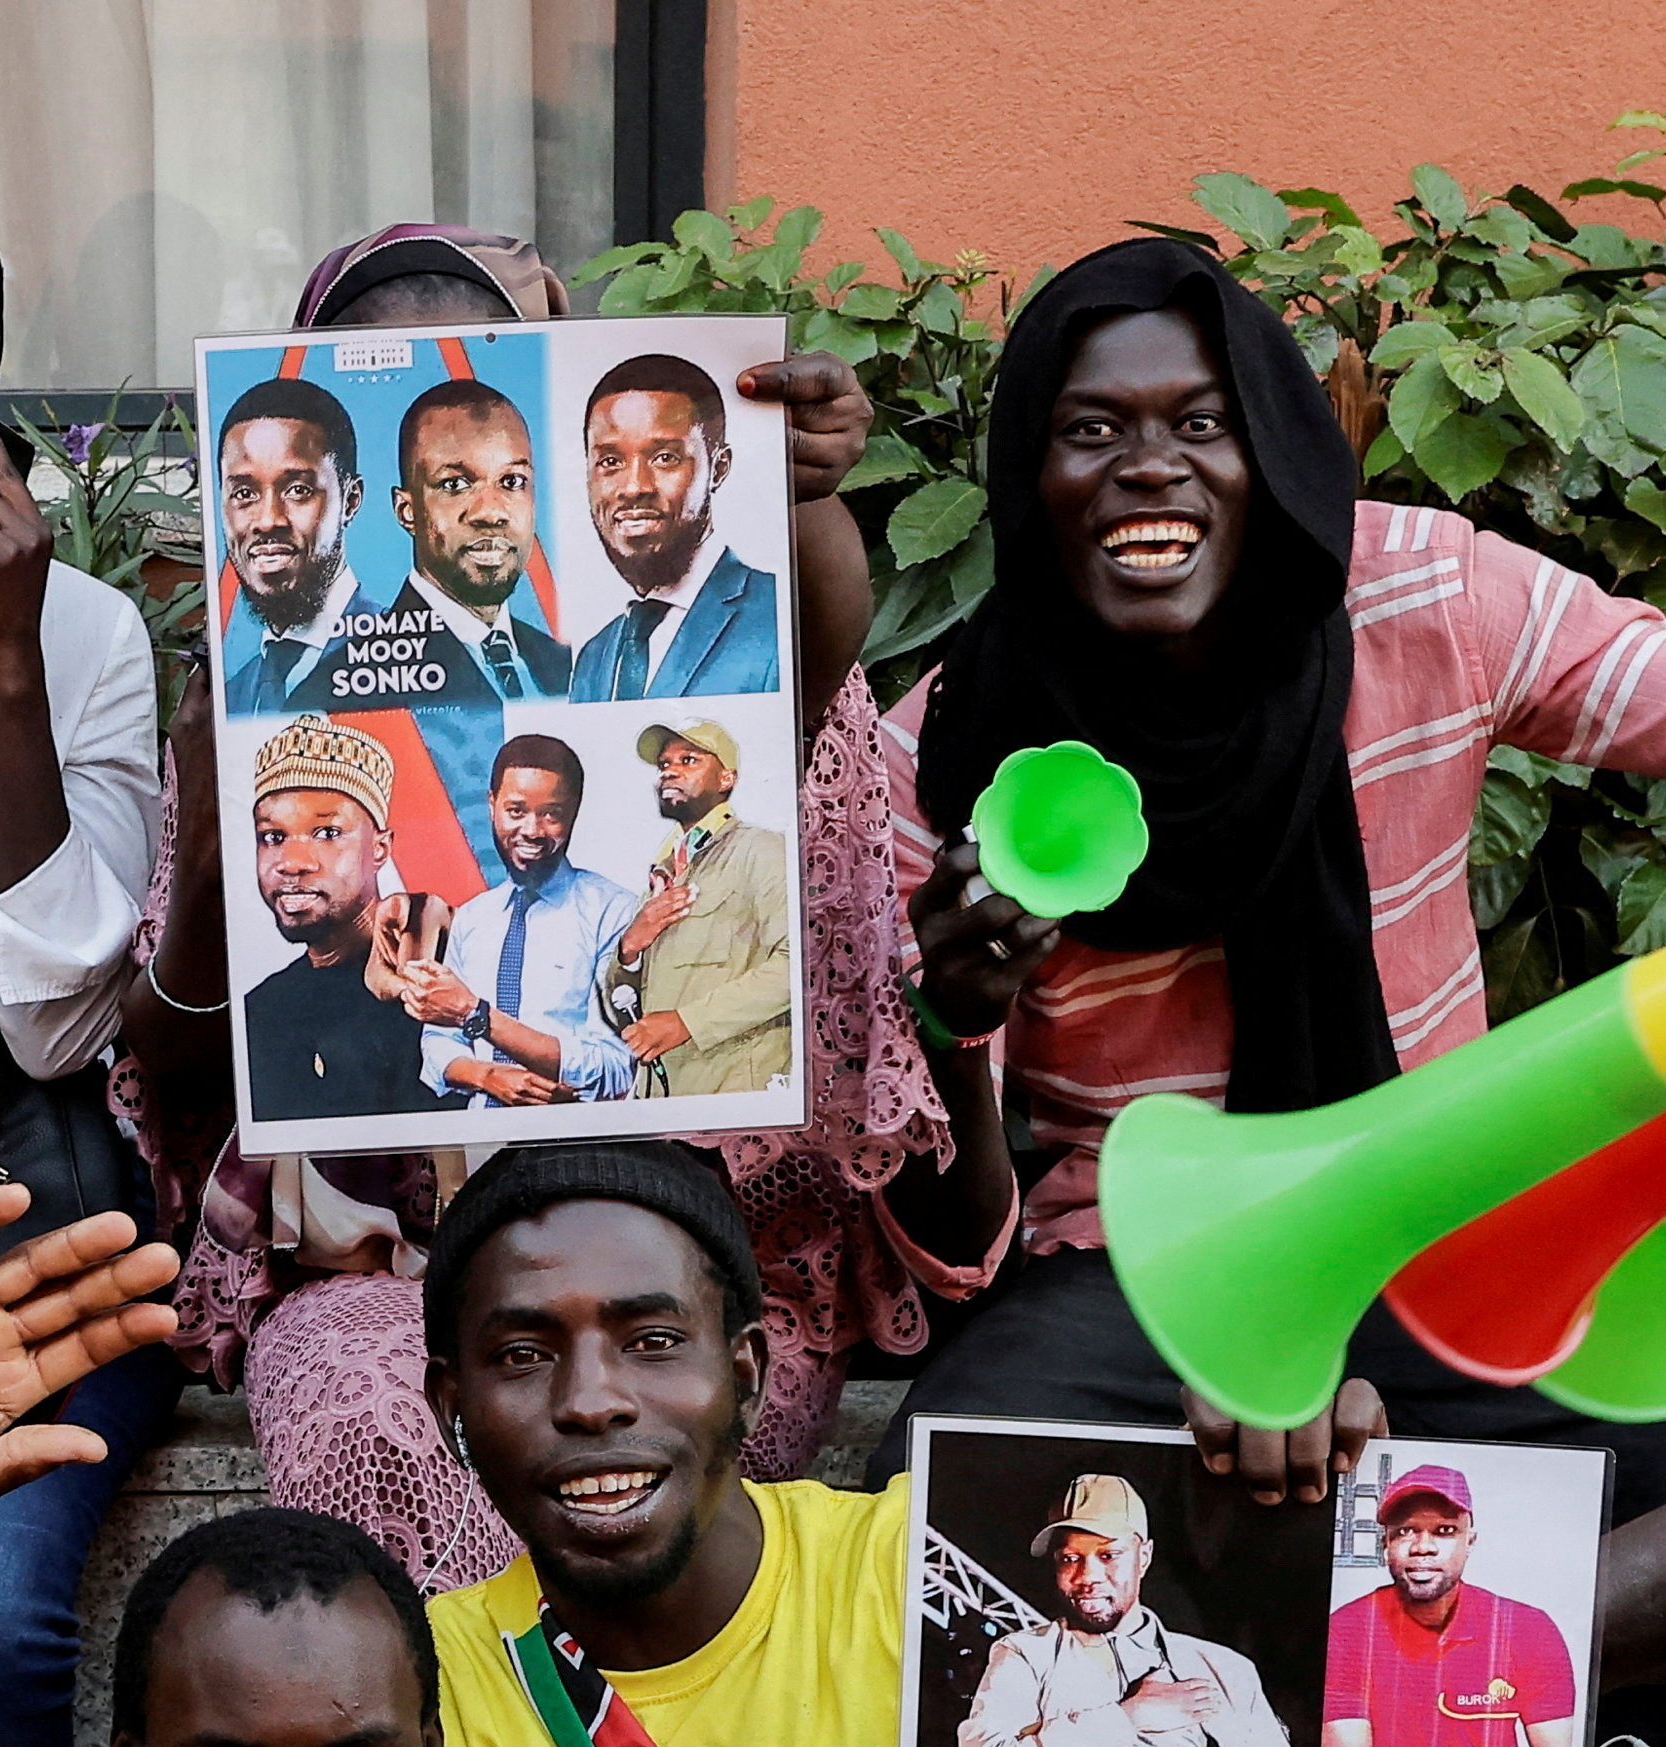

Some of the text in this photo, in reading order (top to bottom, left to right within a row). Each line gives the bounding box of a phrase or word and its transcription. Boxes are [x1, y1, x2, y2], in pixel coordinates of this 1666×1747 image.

[330, 609, 445, 638] DIOMAYE
[347, 637, 428, 665] MOOY
[332, 663, 447, 697] SONKO
